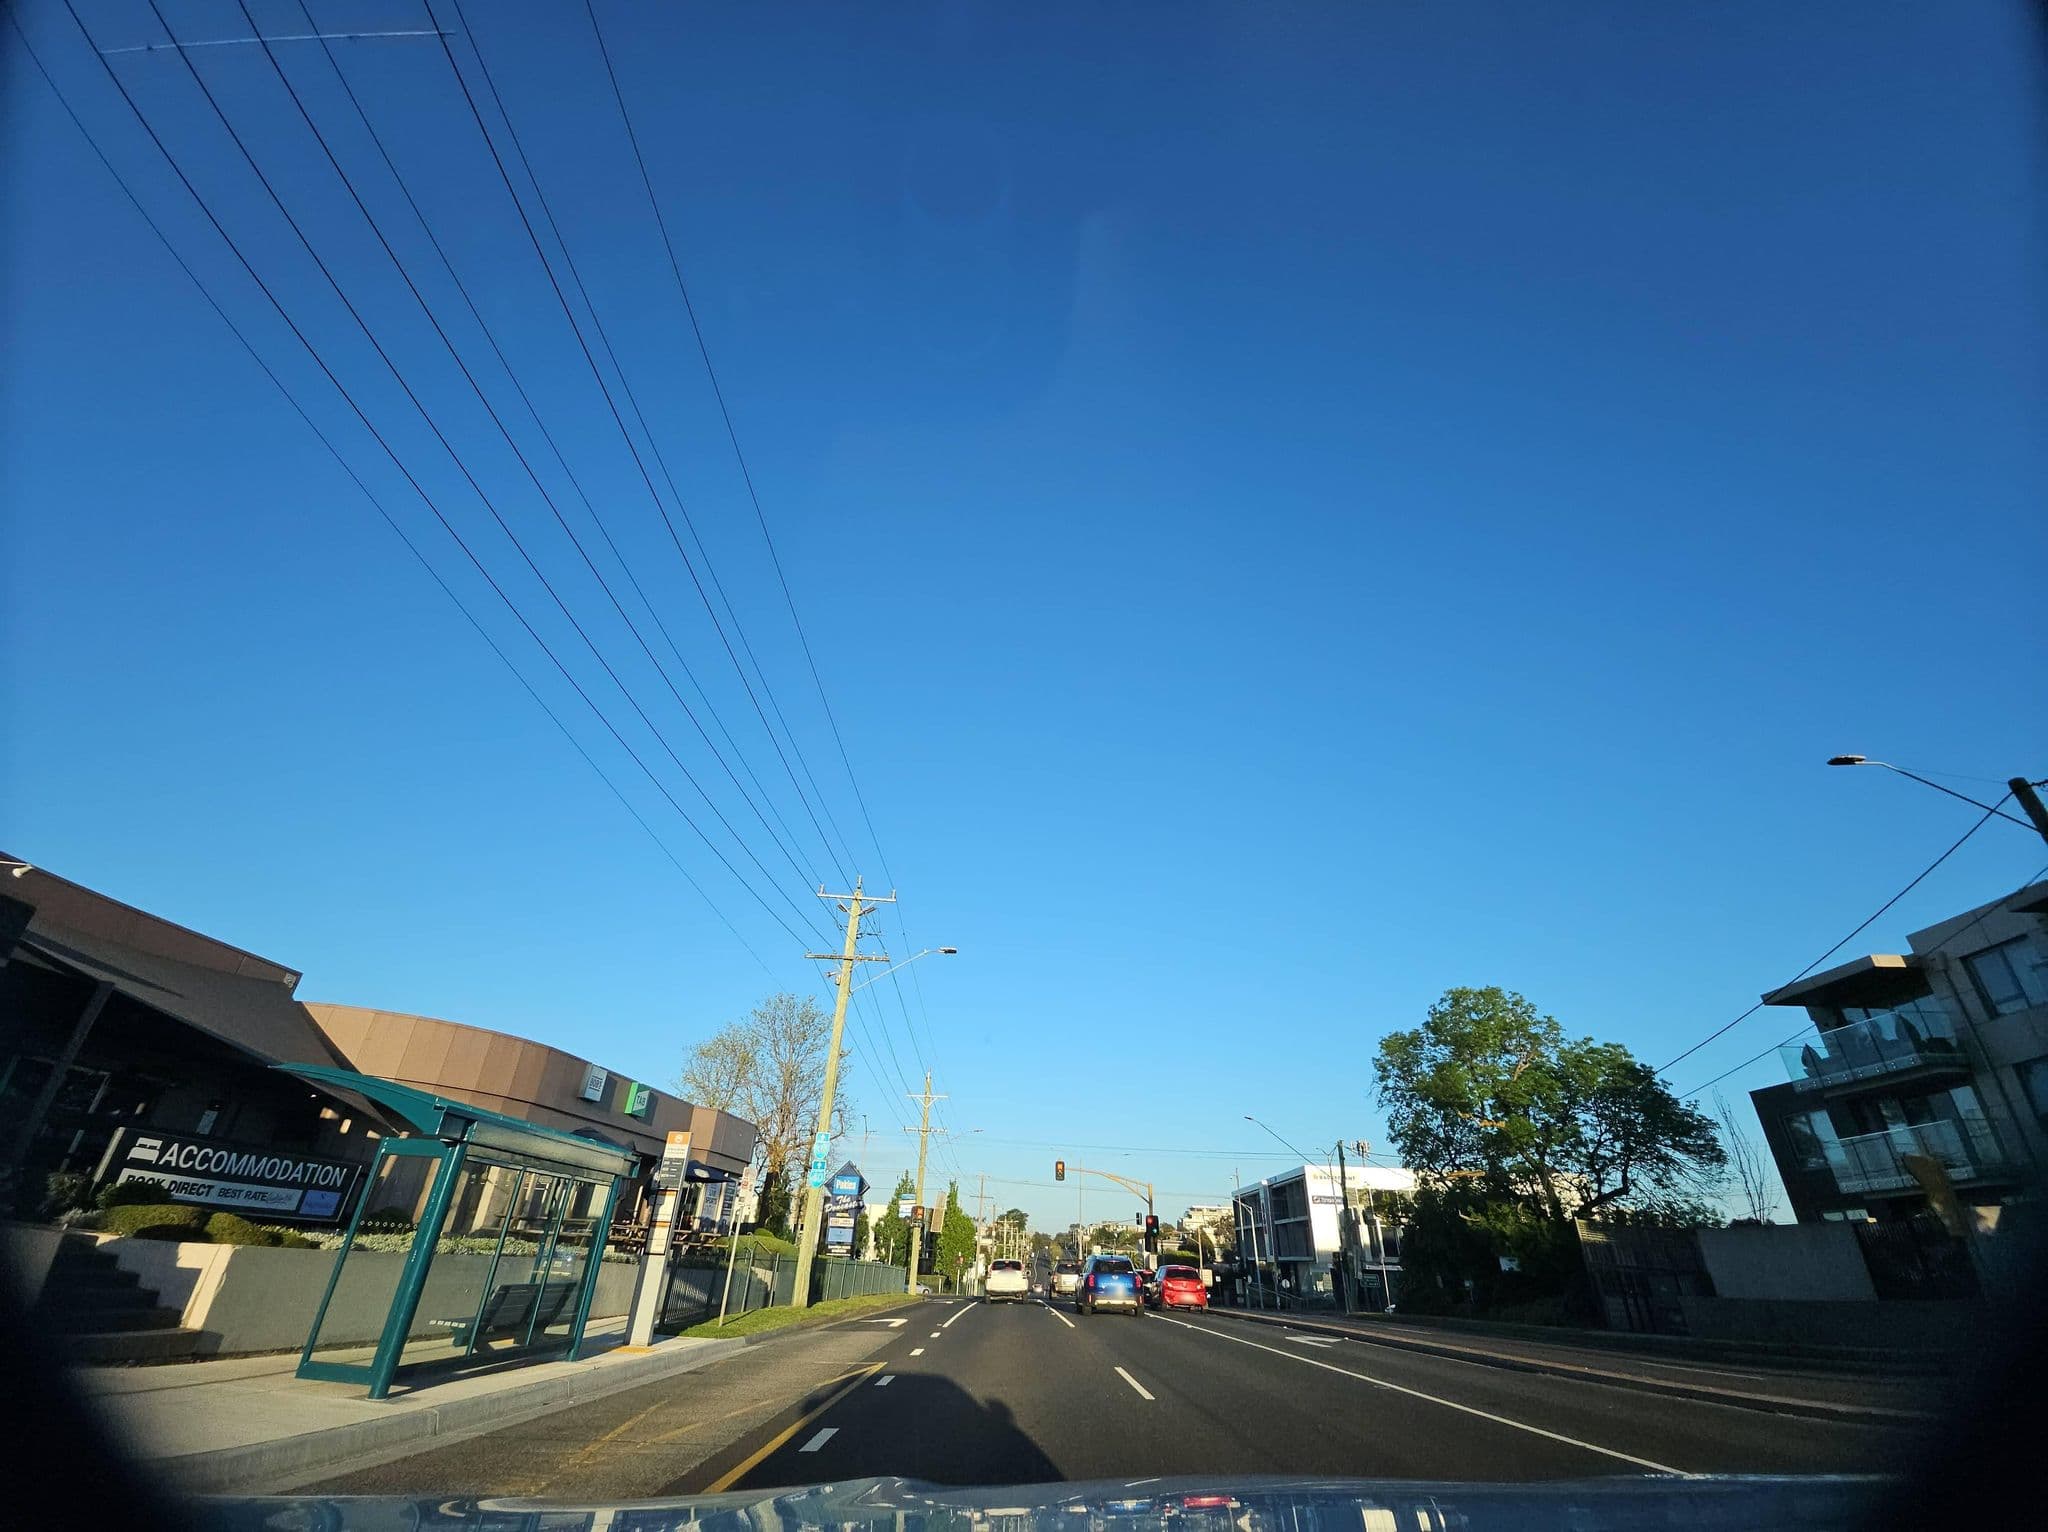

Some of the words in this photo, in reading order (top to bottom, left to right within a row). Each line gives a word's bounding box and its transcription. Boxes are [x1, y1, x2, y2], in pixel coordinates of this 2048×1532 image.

[637, 1095, 647, 1106] TAB
[159, 1143, 347, 1187] ACCOMMODATION
[168, 1180, 214, 1197] DIRECT
[218, 1188, 243, 1199] BEST
[245, 1190, 268, 1201] RATE
